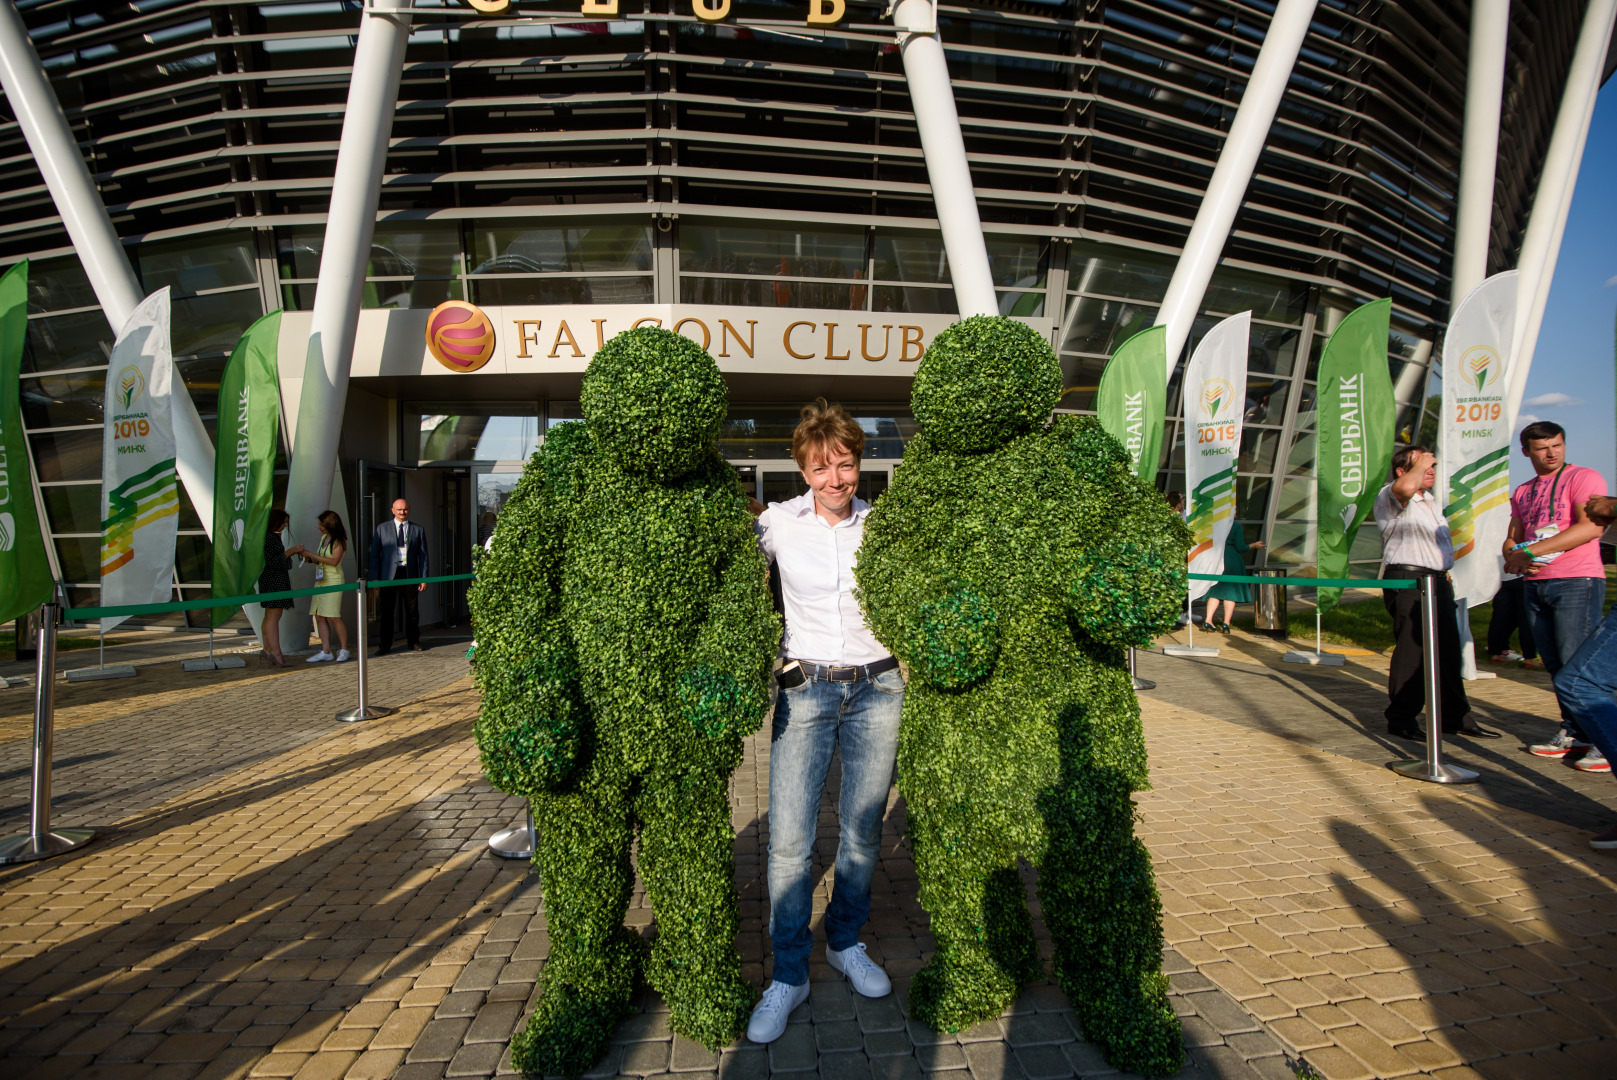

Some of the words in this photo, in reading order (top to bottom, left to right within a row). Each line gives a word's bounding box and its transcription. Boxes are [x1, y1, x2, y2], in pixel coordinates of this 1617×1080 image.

[513, 317, 758, 358] FALON
[783, 321, 925, 362] CLUB
[1456, 402, 1502, 423] 2019
[114, 419, 150, 440] 2019
[1197, 425, 1235, 444] 2019
[1340, 373, 1361, 498] СБЕРБАНК
[1461, 429, 1493, 438] MINSK
[234, 387, 248, 512] SBERBANK
